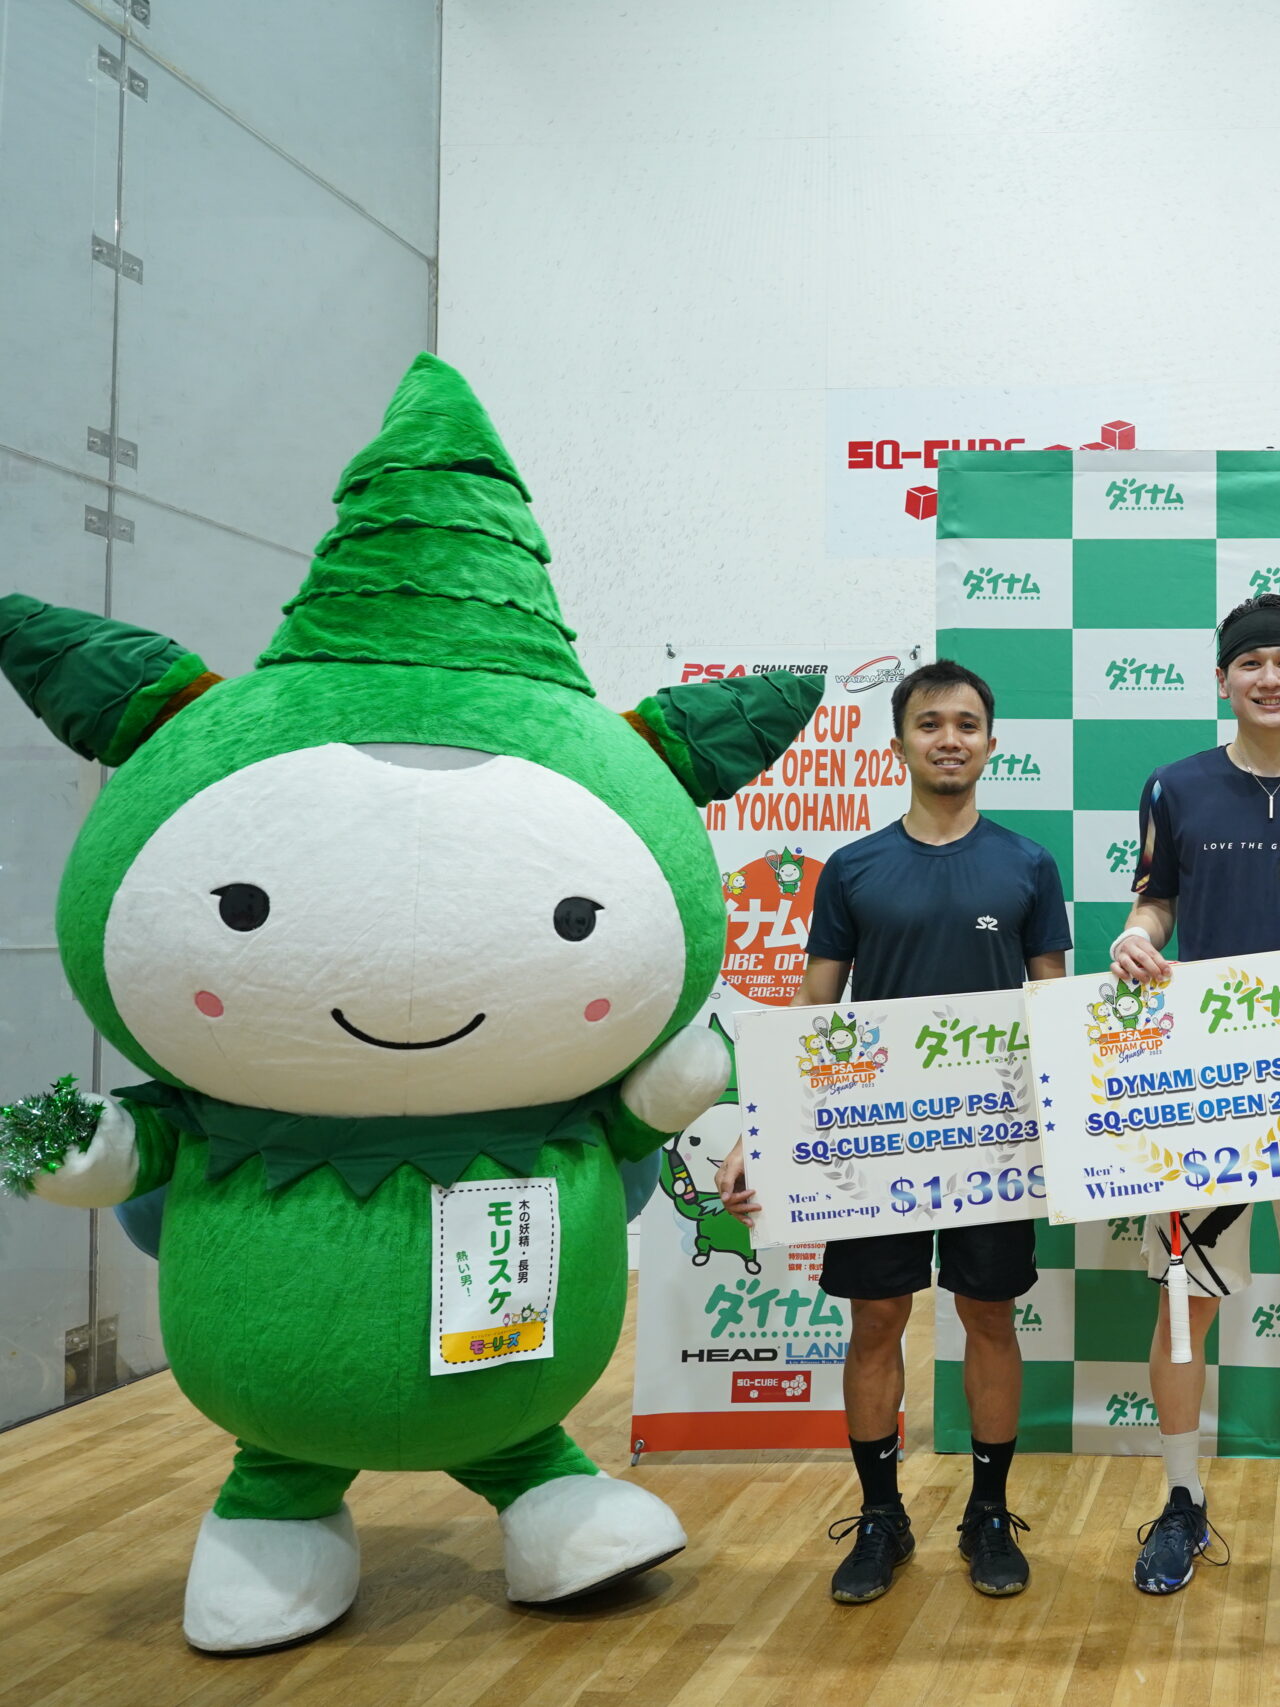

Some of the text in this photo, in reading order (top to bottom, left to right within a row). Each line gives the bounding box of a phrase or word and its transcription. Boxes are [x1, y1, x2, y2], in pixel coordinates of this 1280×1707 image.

[1105, 478, 1184, 510] ダイナム
[963, 567, 1041, 599] ダイナム
[1105, 657, 1184, 690] ダイナム
[813, 704, 861, 743] CUP
[782, 749, 845, 787] OPEN
[706, 793, 871, 831] in YOKOHAMA
[1203, 842, 1233, 850] LOVE
[1241, 842, 1263, 850] THE
[915, 1018, 1031, 1069] ダイナム
[1100, 1040, 1163, 1057] DYNAM CUP
[1119, 1030, 1141, 1042] PSA
[810, 1073, 876, 1088] DYNAM CUP
[832, 1063, 854, 1074] PSA
[1107, 1067, 1194, 1097] DYNAM
[1200, 1062, 1249, 1085] CUP
[816, 1091, 1016, 1127] DYNAM CUP PSA
[1087, 1103, 1193, 1134] SQ-CUBE
[1199, 1093, 1264, 1119] OPEN
[794, 1120, 1039, 1161] SQ-CUBE OPEN 2023
[1084, 1178, 1165, 1200] Winner
[791, 1205, 880, 1223] Runner-up
[487, 1201, 513, 1315] モリスケ
[704, 1278, 844, 1339] ダイナム
[681, 1348, 778, 1363] HEAD
[737, 1378, 779, 1387] SQ-CUBE
